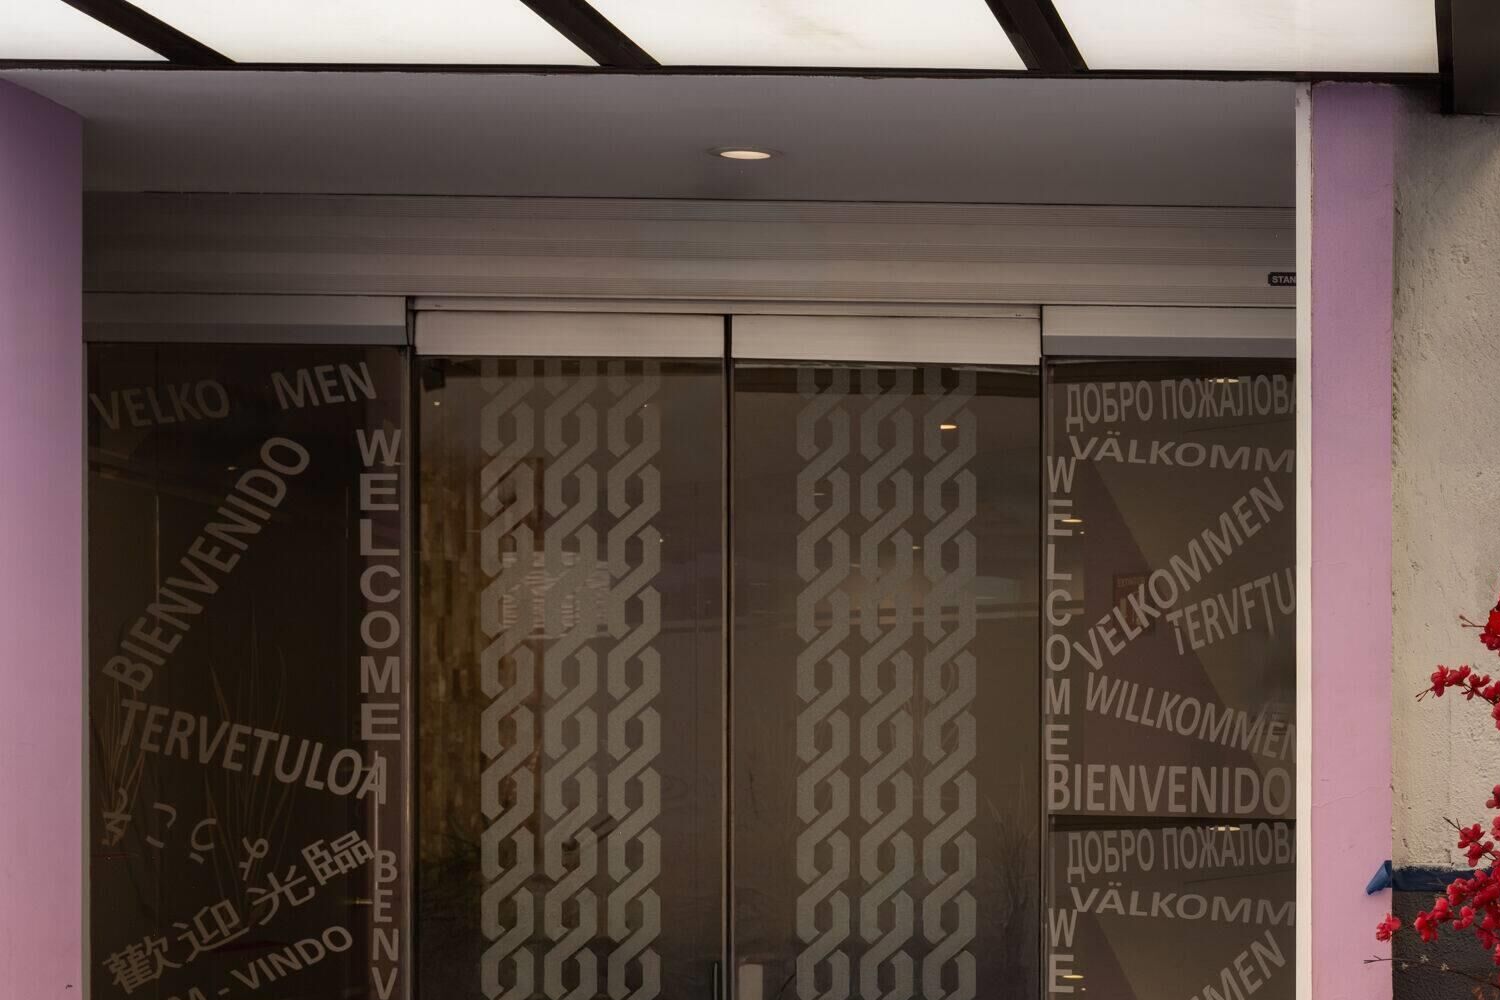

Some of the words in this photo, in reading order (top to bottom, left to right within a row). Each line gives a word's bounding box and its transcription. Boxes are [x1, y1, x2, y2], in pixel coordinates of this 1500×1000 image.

[270, 362, 377, 409] MEN
[1066, 380, 1154, 432] ДОБРО
[102, 437, 311, 692] BIENVENIDO
[356, 429, 401, 741] WELCOME
[1072, 476, 1286, 671] VELKOMMEN
[1045, 455, 1076, 761] WELCOME
[119, 700, 386, 804] TERVETULOA
[1049, 764, 1291, 816] BIENVENIDO
[1066, 828, 1154, 884] ДОБРО
[231, 924, 354, 992] VINDO
